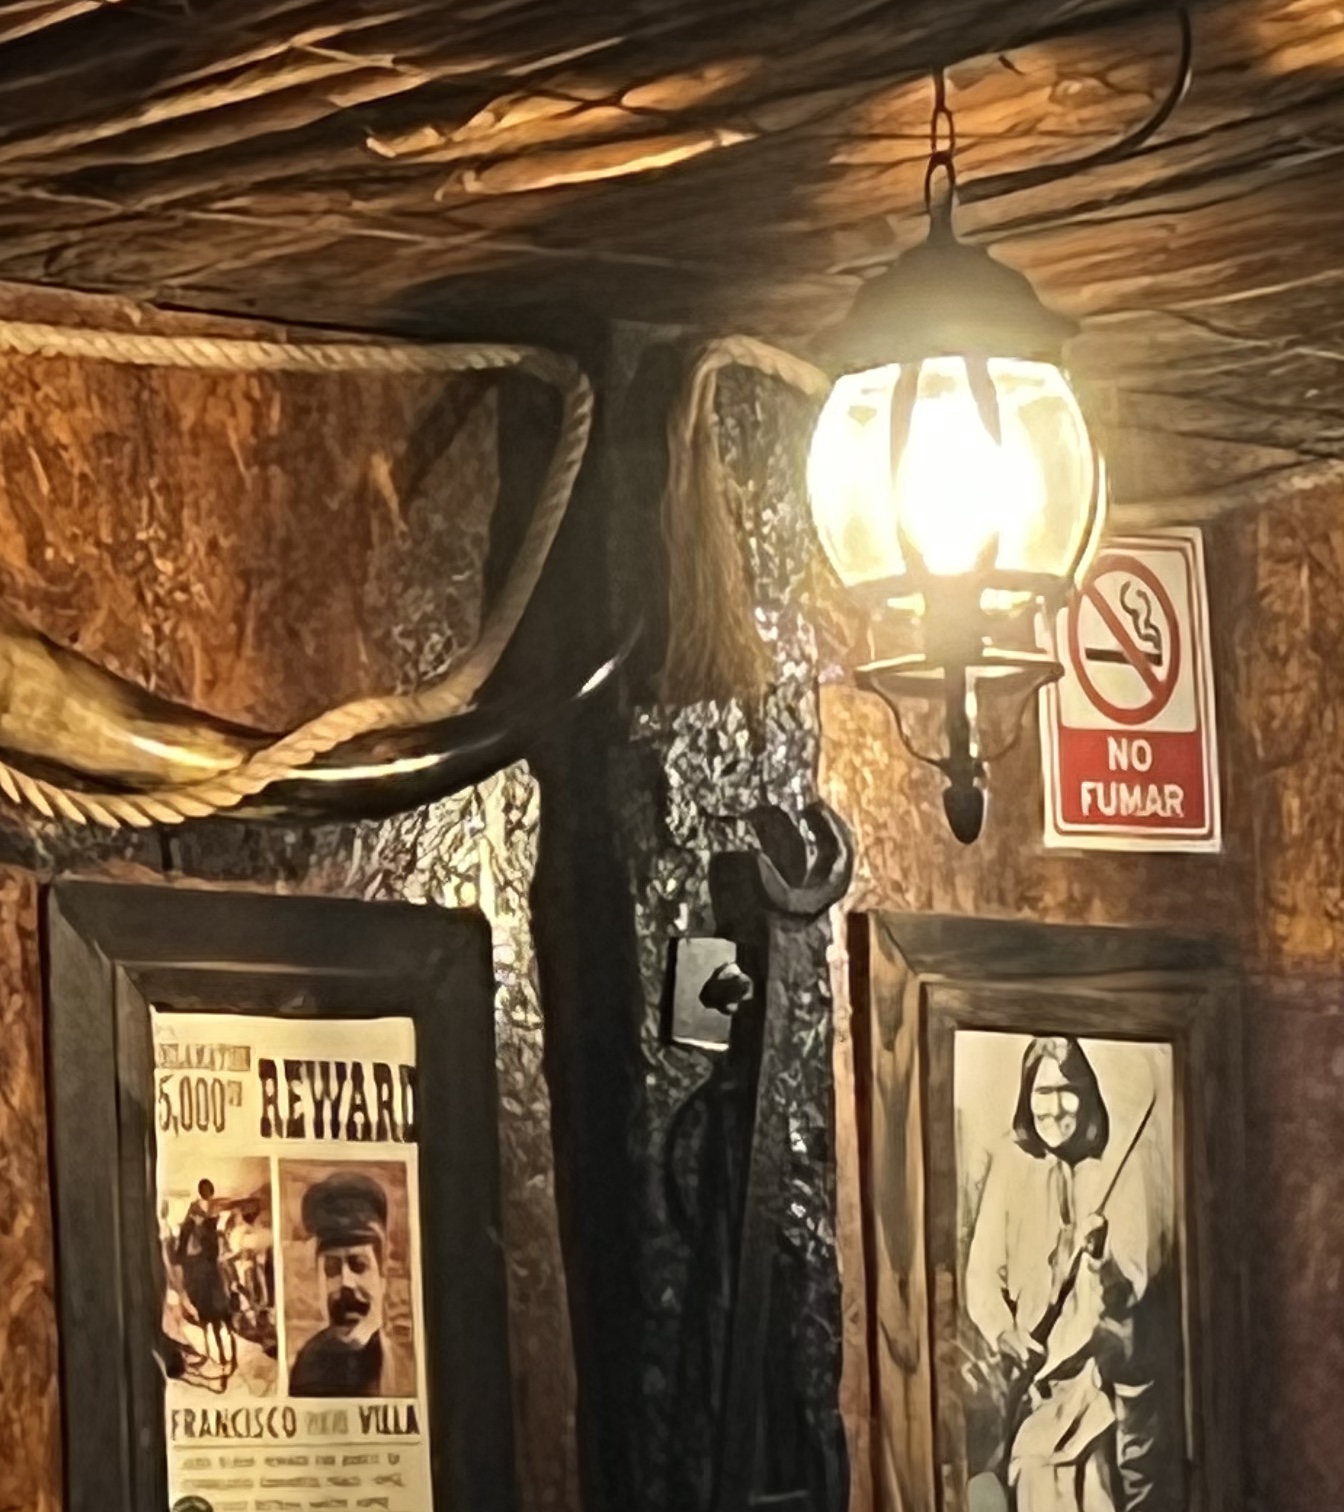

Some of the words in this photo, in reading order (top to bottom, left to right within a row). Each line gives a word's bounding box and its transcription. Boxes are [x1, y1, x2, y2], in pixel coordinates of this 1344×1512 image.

[1107, 736, 1152, 772] NO
[1080, 780, 1184, 818] FUMAR
[258, 1057, 416, 1143] REWARD
[171, 1405, 297, 1441] FRANCISCO
[358, 1404, 421, 1437] VILLA
